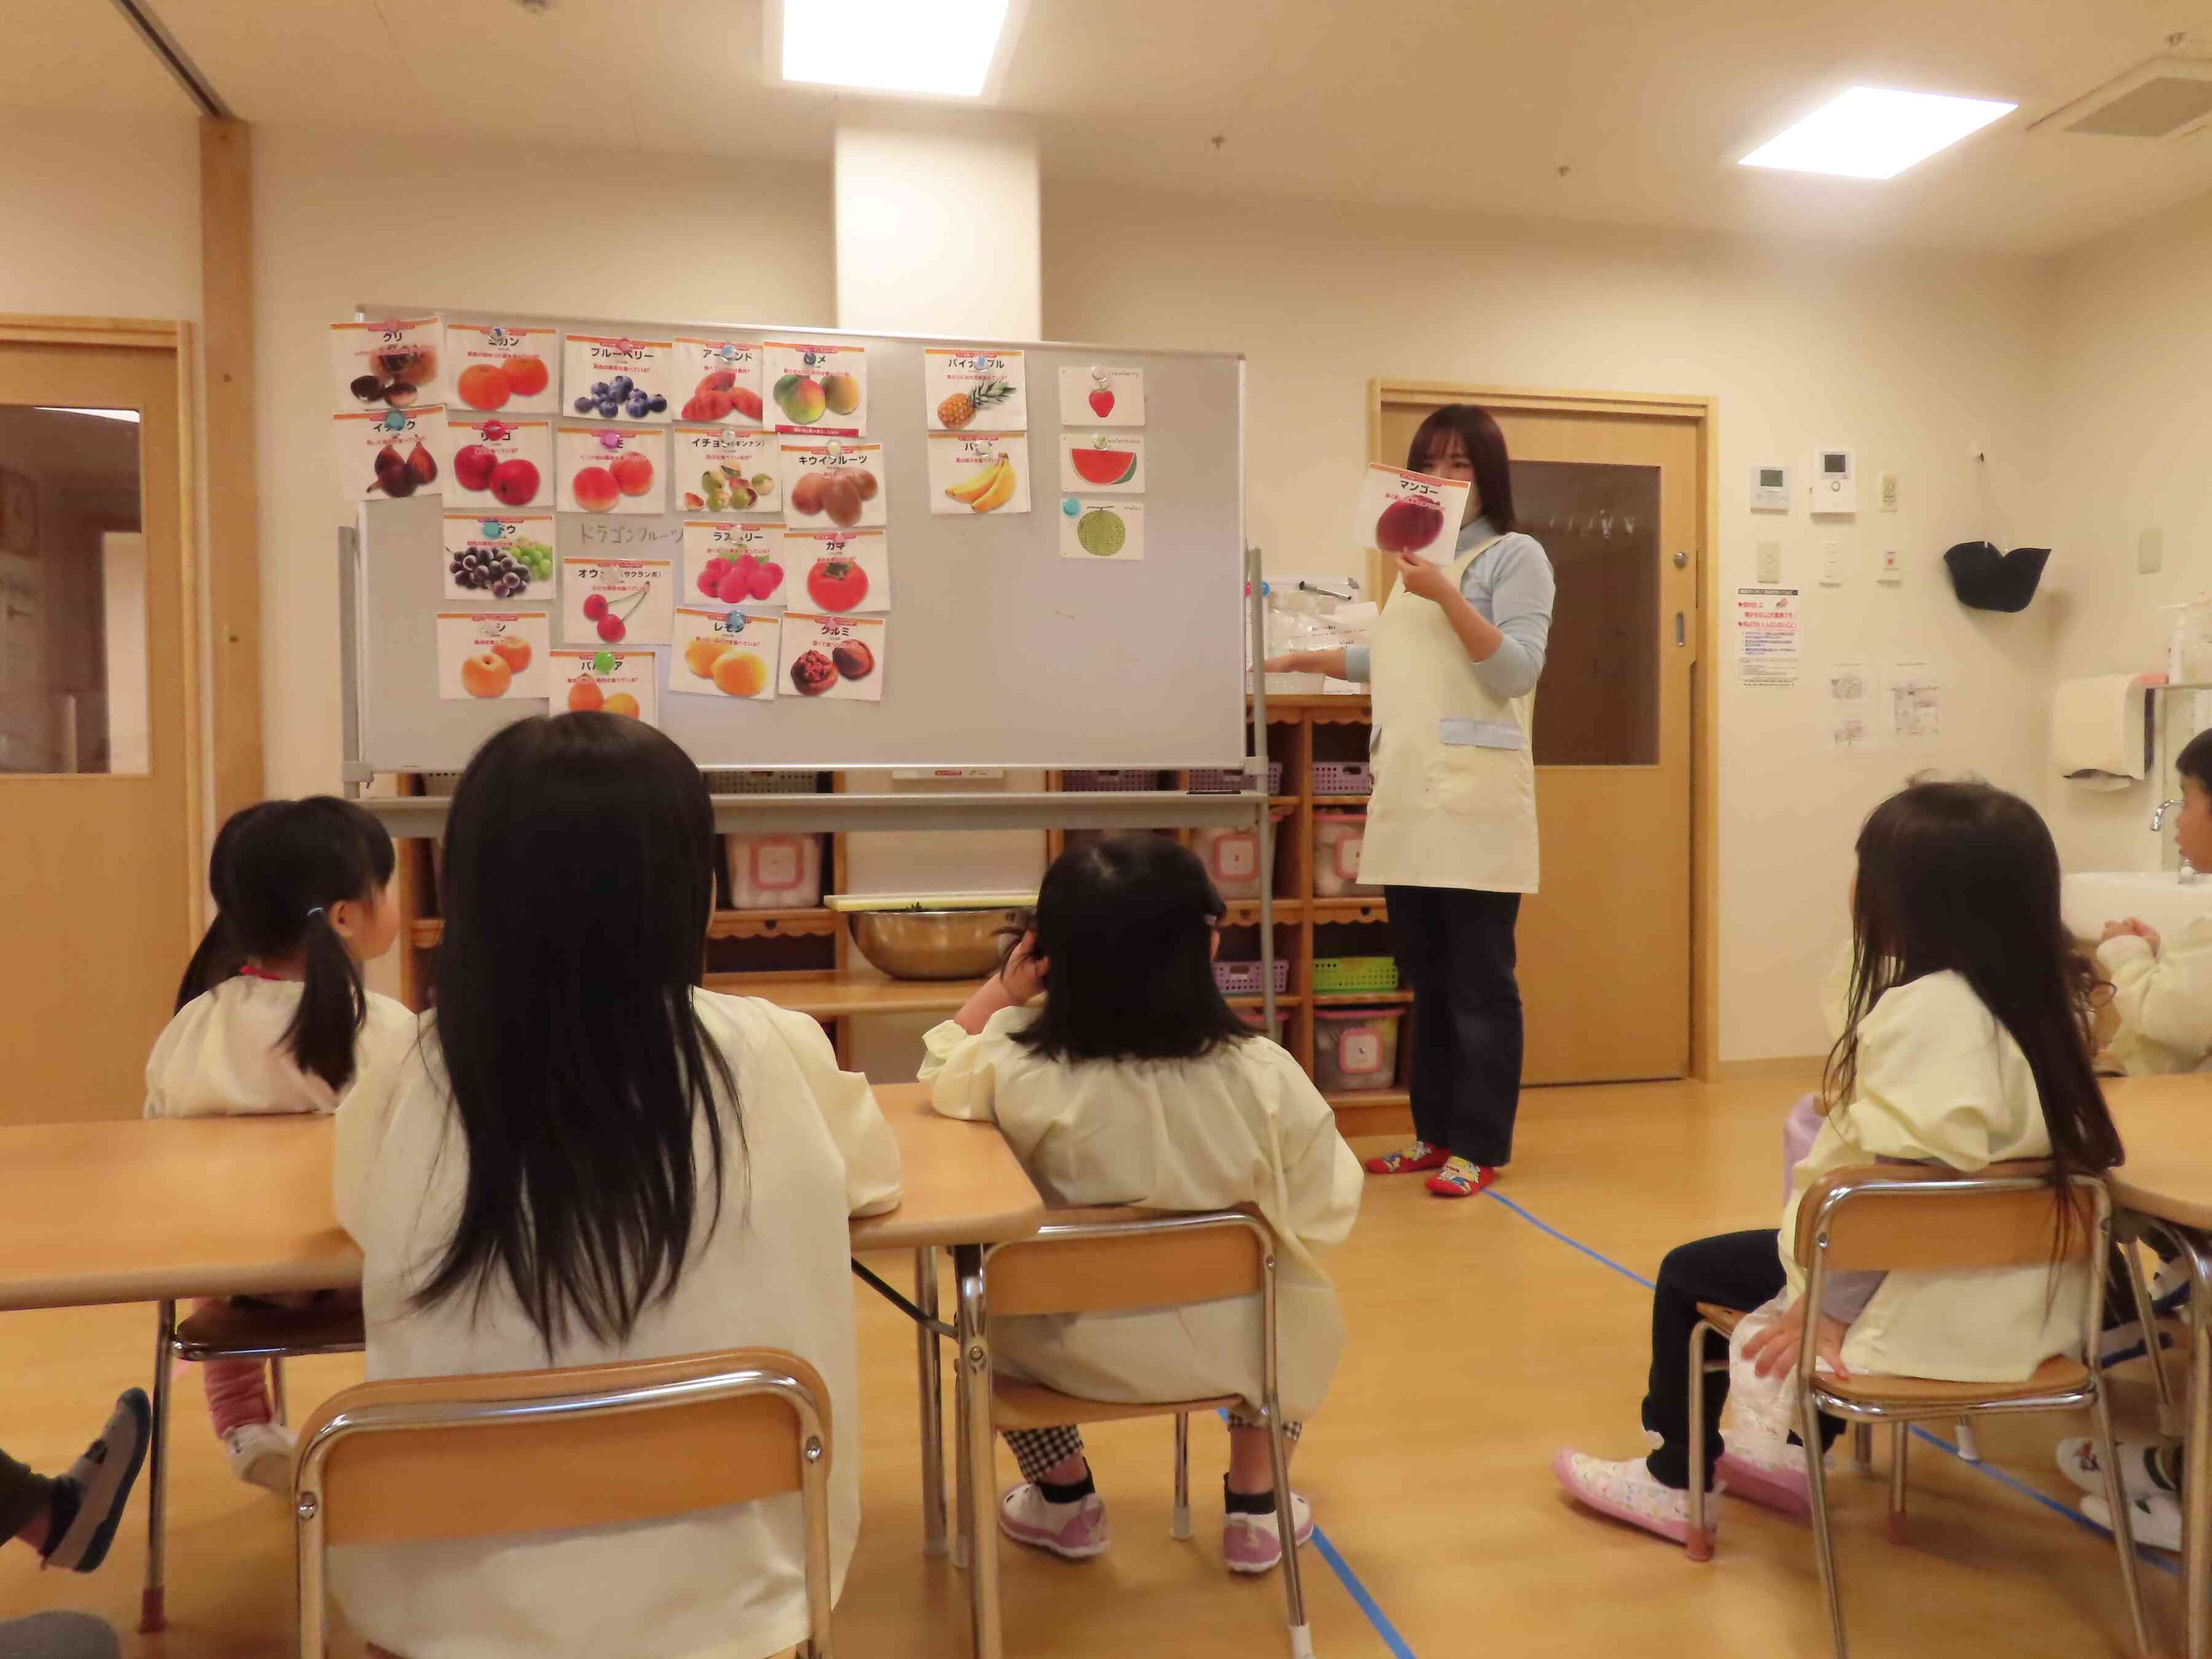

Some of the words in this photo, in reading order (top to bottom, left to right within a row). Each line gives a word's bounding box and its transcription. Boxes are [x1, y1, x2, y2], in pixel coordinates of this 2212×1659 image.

[383, 331, 402, 342] クリ
[702, 349, 753, 362] アーンド
[948, 358, 1005, 369] パイナプル
[481, 431, 511, 441] リゴ
[1400, 480, 1439, 494] マンゴー
[581, 523, 684, 545] ドラゴンフルーツ
[826, 541, 845, 551] カキ
[821, 626, 850, 637] クルミ
[581, 661, 623, 670] パア
